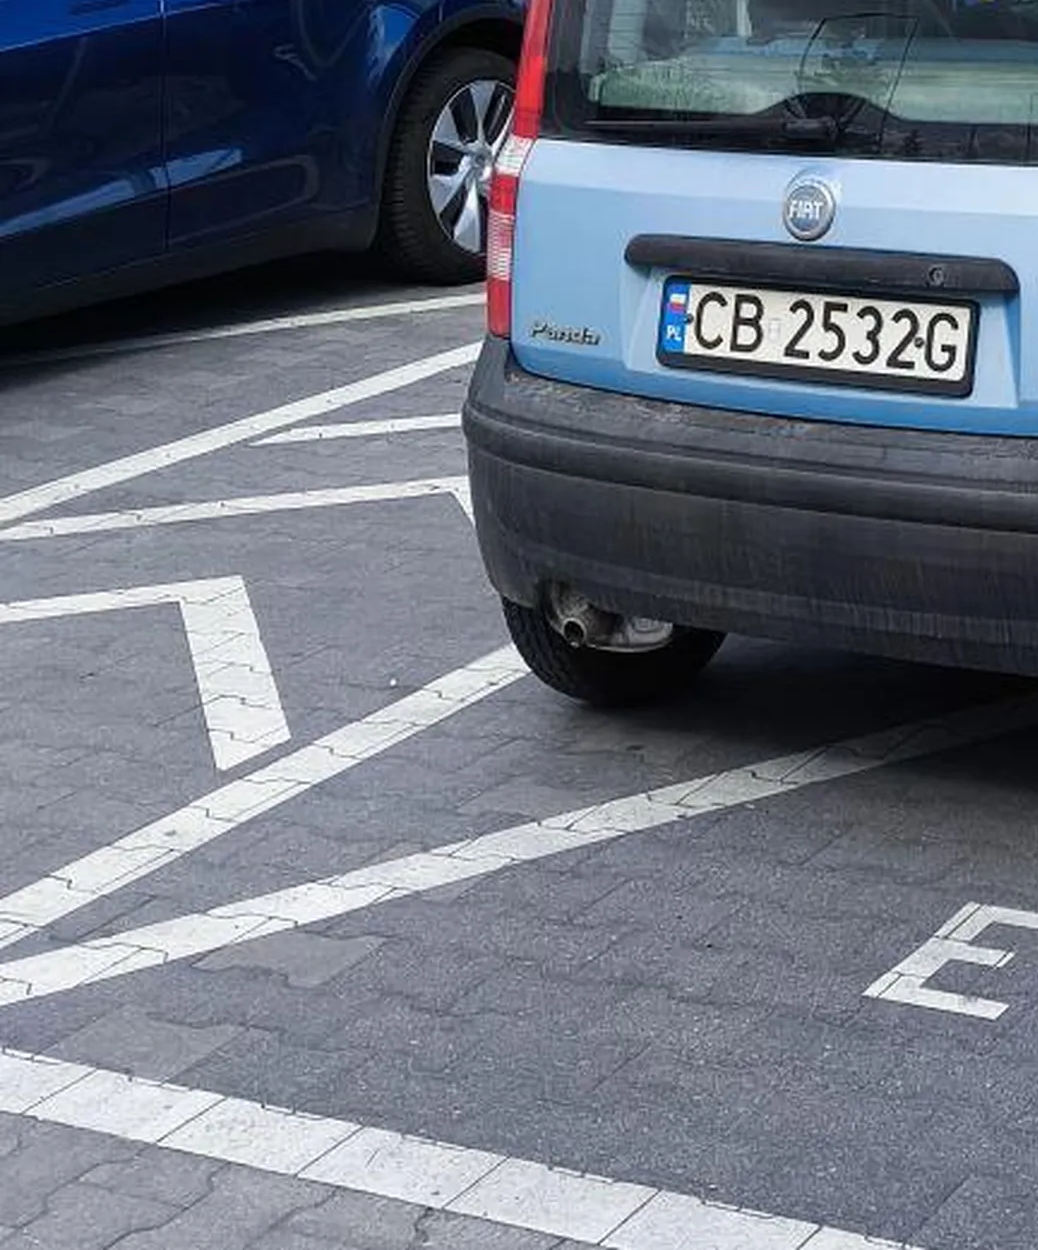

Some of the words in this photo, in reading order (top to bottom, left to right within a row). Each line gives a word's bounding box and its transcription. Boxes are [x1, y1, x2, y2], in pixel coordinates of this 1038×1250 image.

[789, 199, 825, 221] FIAT
[531, 321, 601, 346] Panda
[666, 324, 683, 342] PL
[694, 291, 765, 353] CB
[783, 298, 961, 373] 2532G
